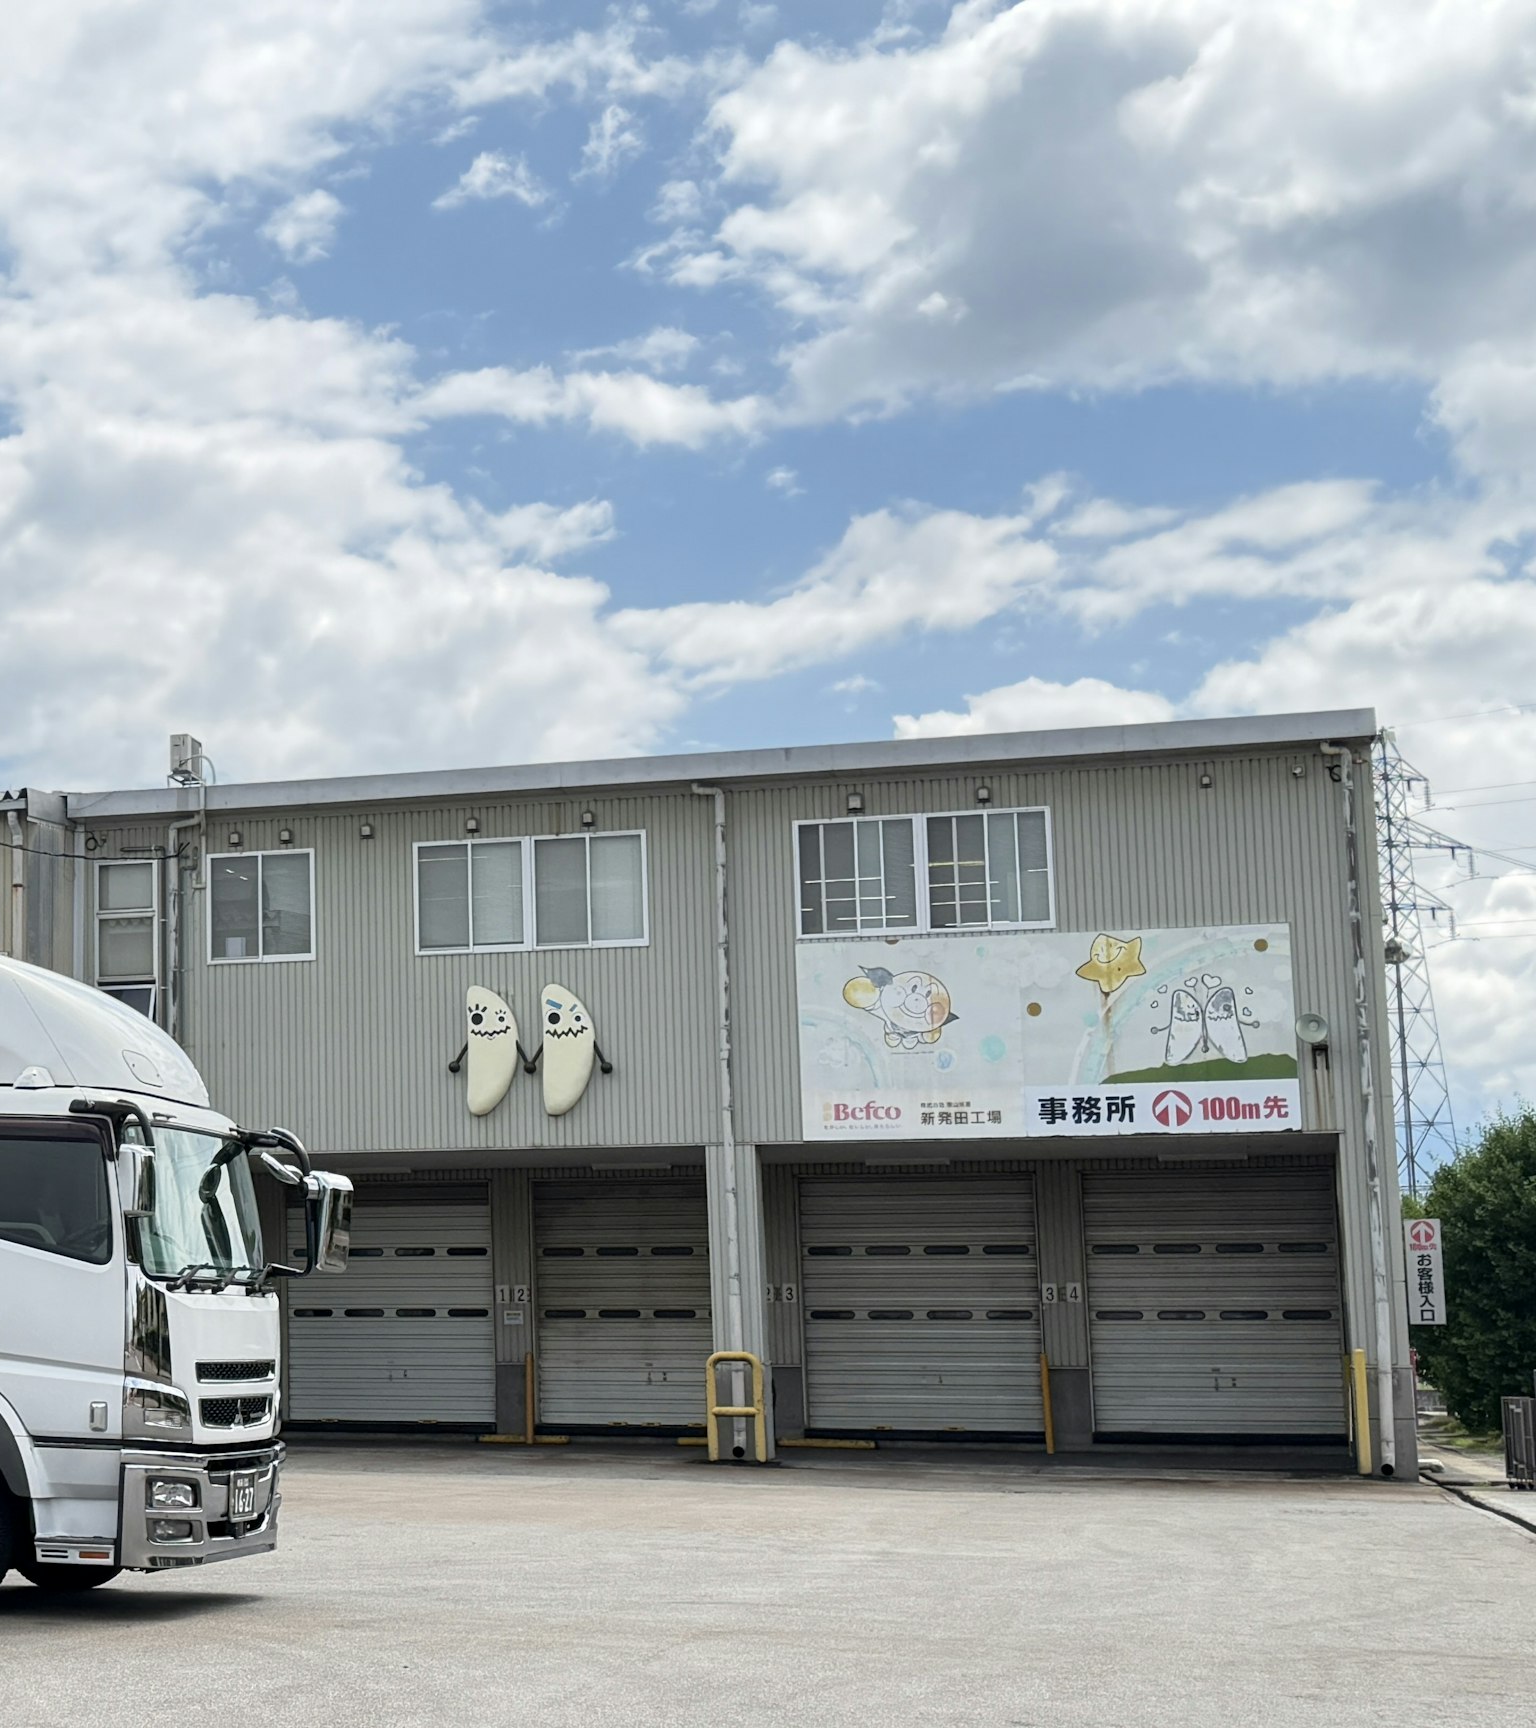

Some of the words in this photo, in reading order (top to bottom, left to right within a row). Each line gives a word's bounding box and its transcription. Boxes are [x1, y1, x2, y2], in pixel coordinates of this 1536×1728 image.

[834, 1100, 901, 1121] Befco
[921, 1110, 1002, 1125] 新発田工場
[1038, 1095, 1135, 1125] 事務所
[1198, 1096, 1289, 1121] 100m先
[517, 1288, 525, 1302] 2
[785, 1286, 794, 1301] 3
[1046, 1286, 1055, 1301] 3
[1069, 1286, 1079, 1301] 4
[1417, 1254, 1435, 1322] お客様入口
